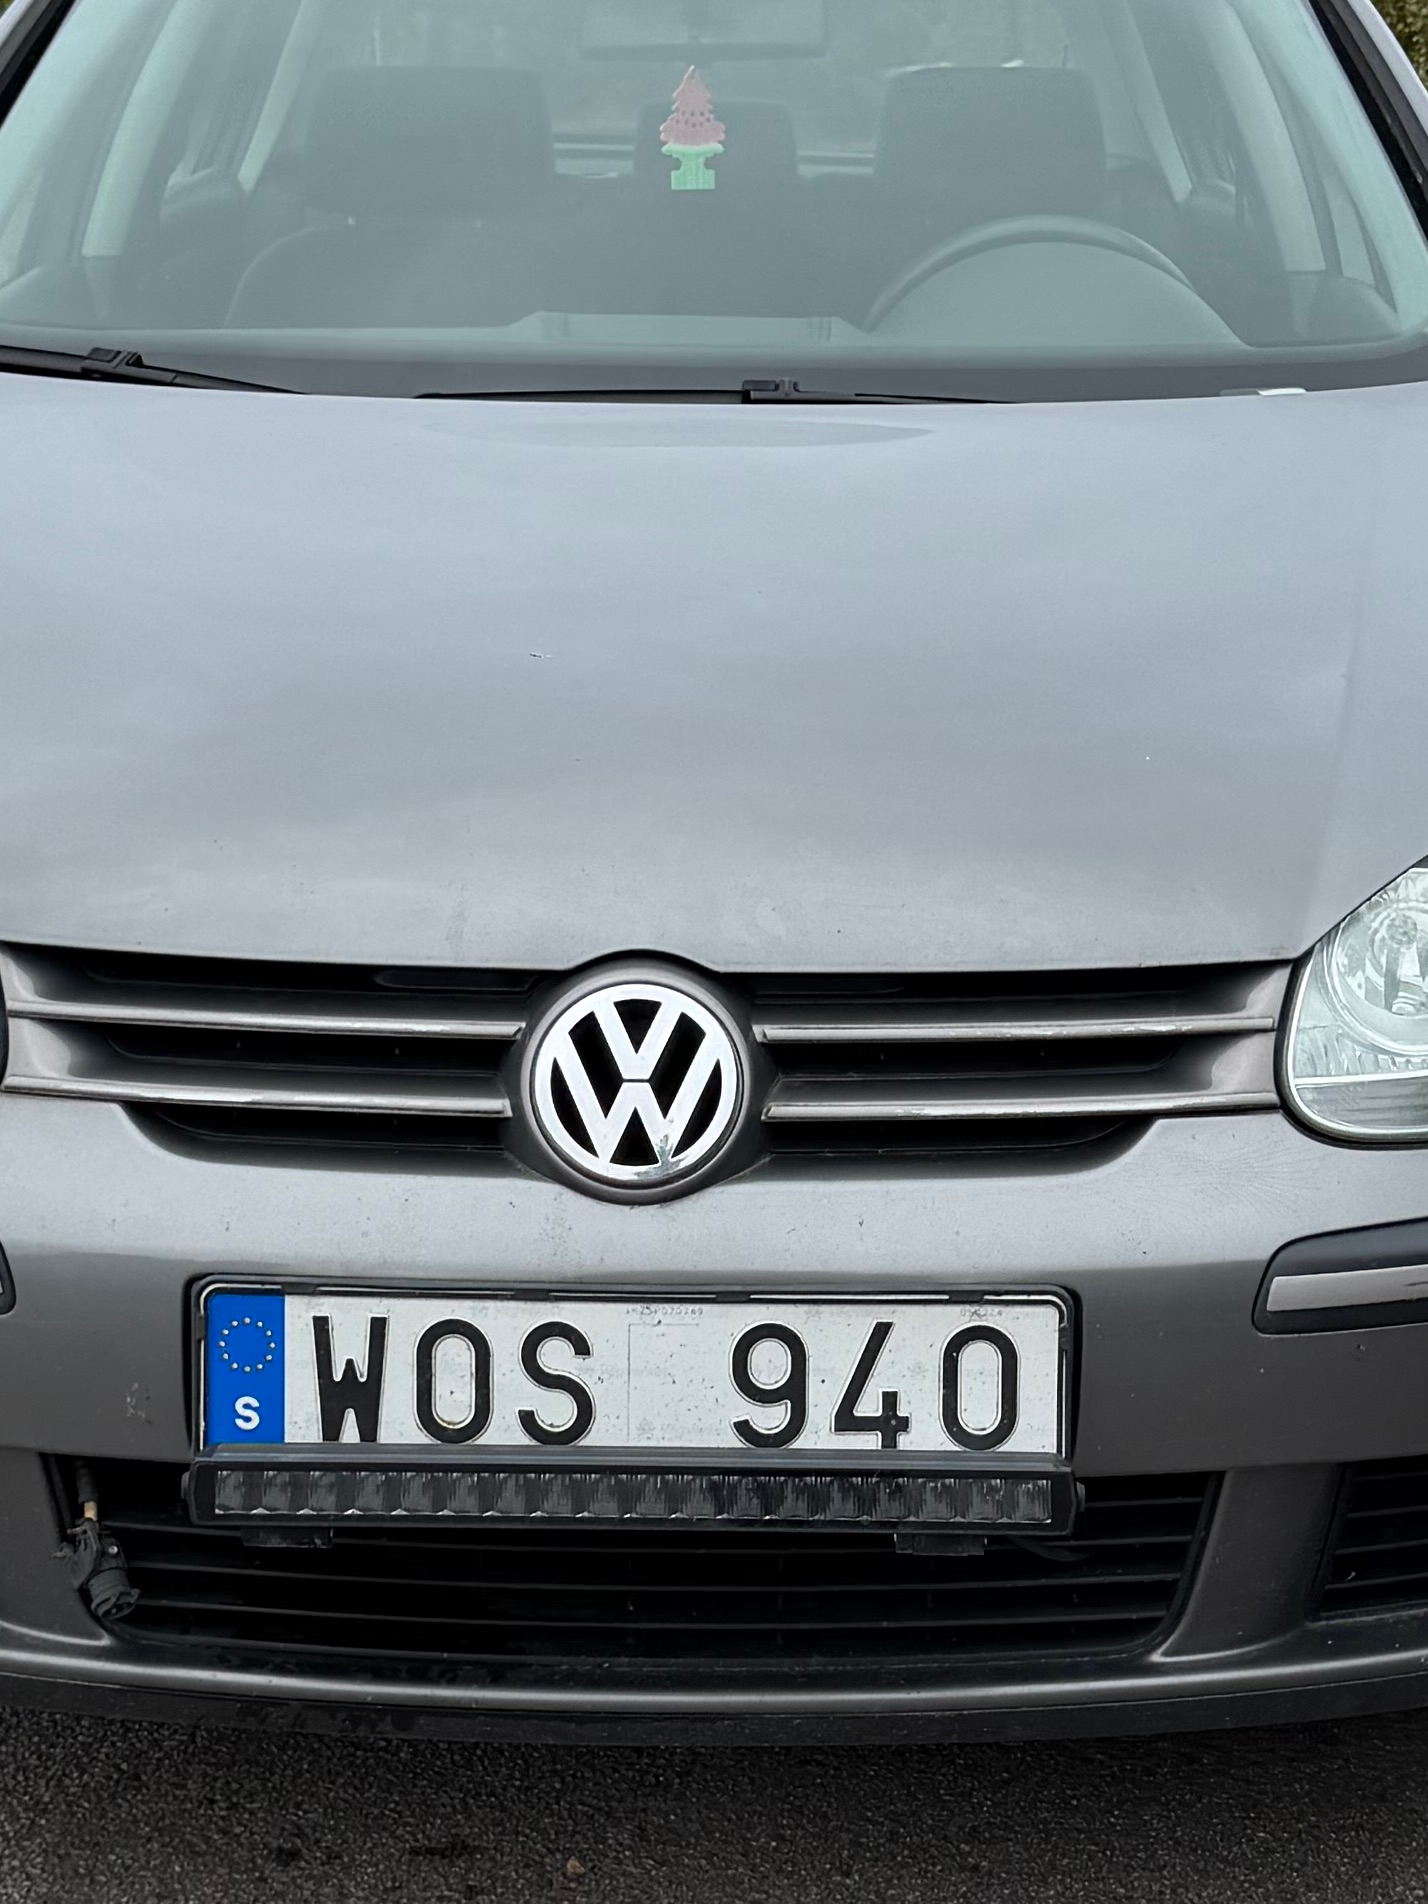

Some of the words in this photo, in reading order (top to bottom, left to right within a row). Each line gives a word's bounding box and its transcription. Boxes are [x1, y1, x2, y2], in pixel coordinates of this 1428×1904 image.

[534, 983, 737, 1181] VW
[234, 1396, 260, 1431] S
[312, 1314, 594, 1445] WOS
[732, 1321, 1019, 1451] 940
